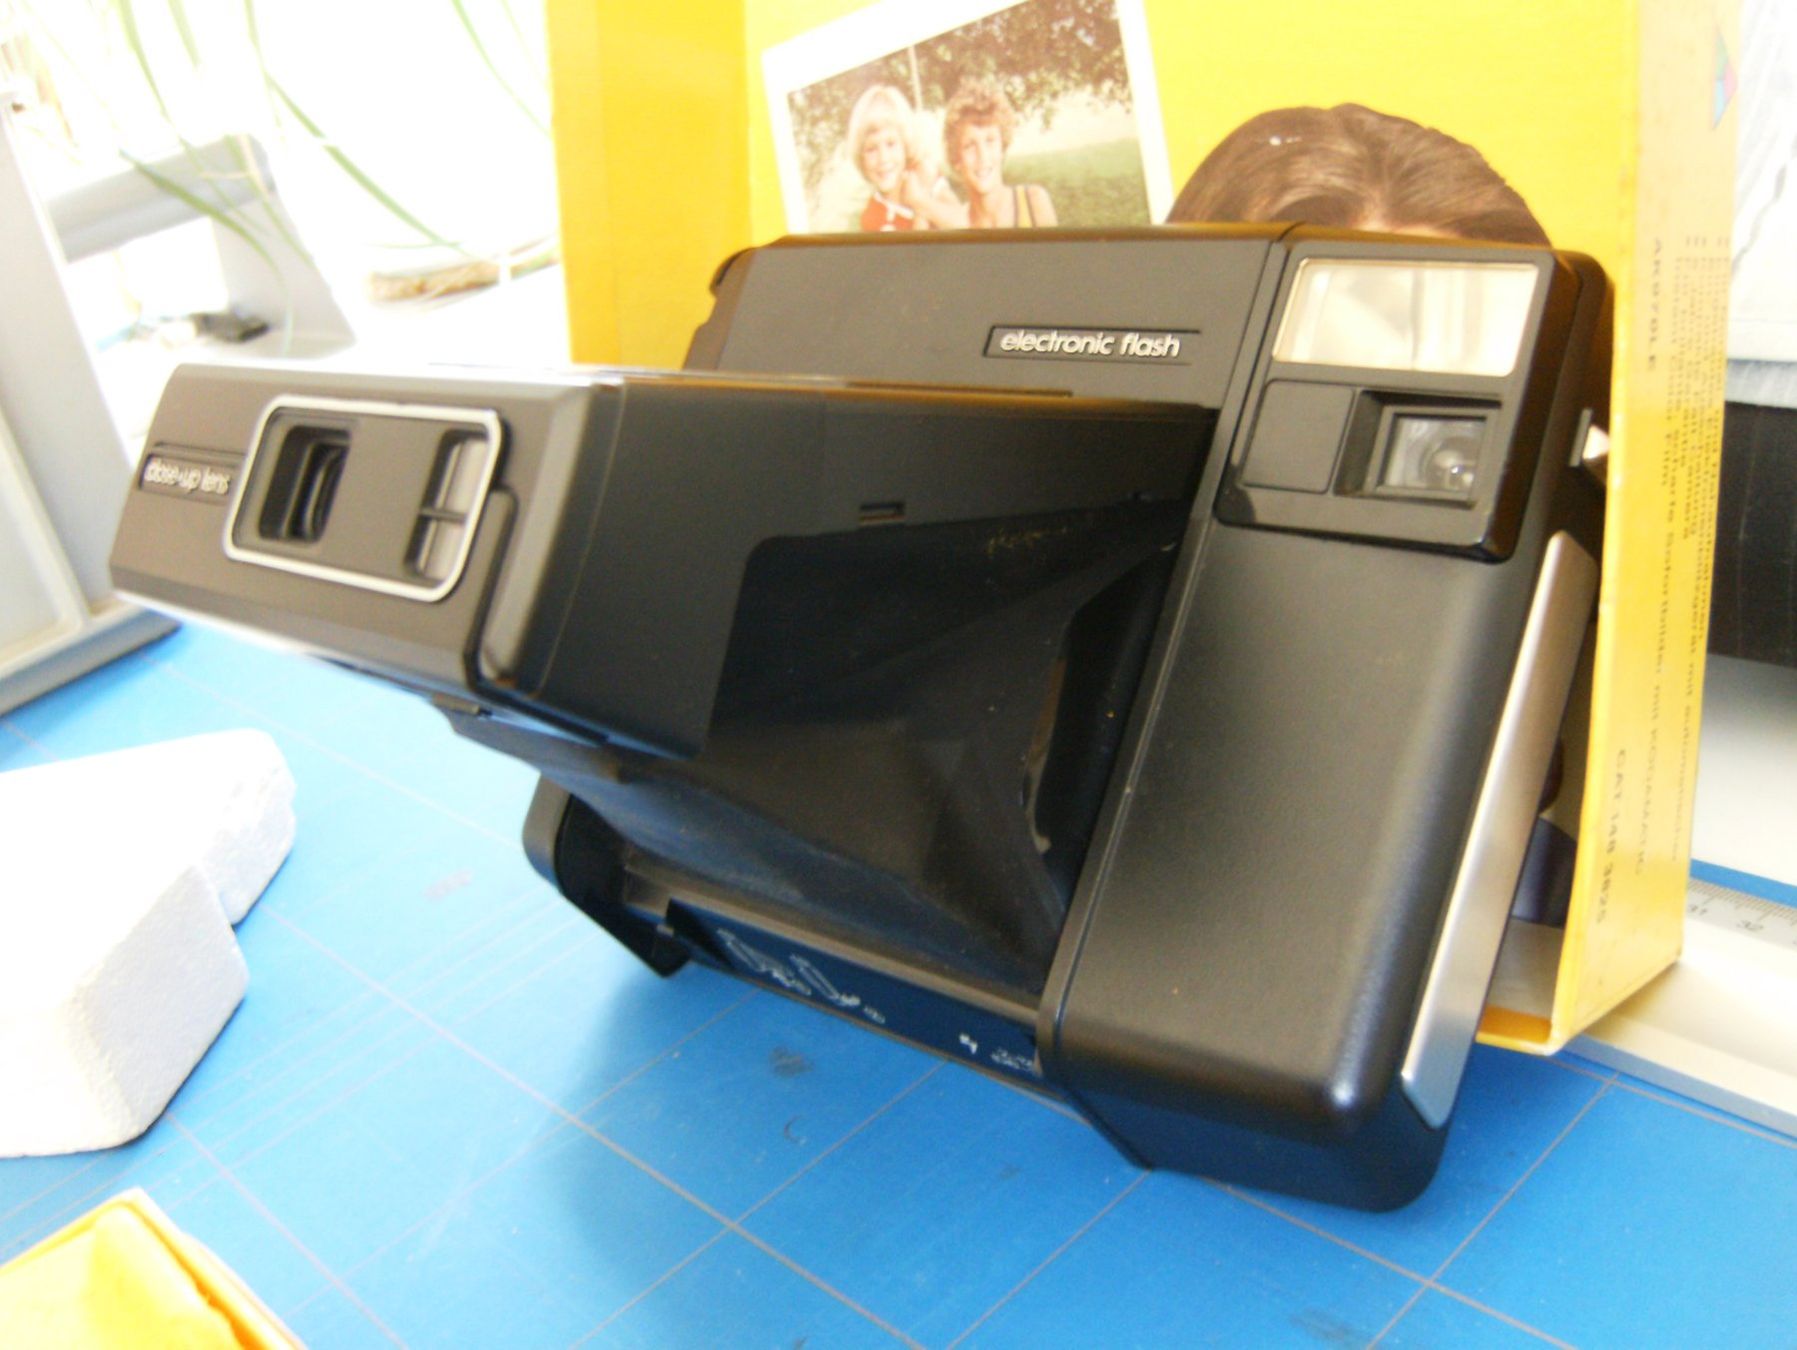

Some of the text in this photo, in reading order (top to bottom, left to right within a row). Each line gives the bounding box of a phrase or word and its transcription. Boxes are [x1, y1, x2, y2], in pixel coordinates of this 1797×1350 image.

[1000, 330, 1181, 358] electronic flash
[201, 465, 231, 495] lens
